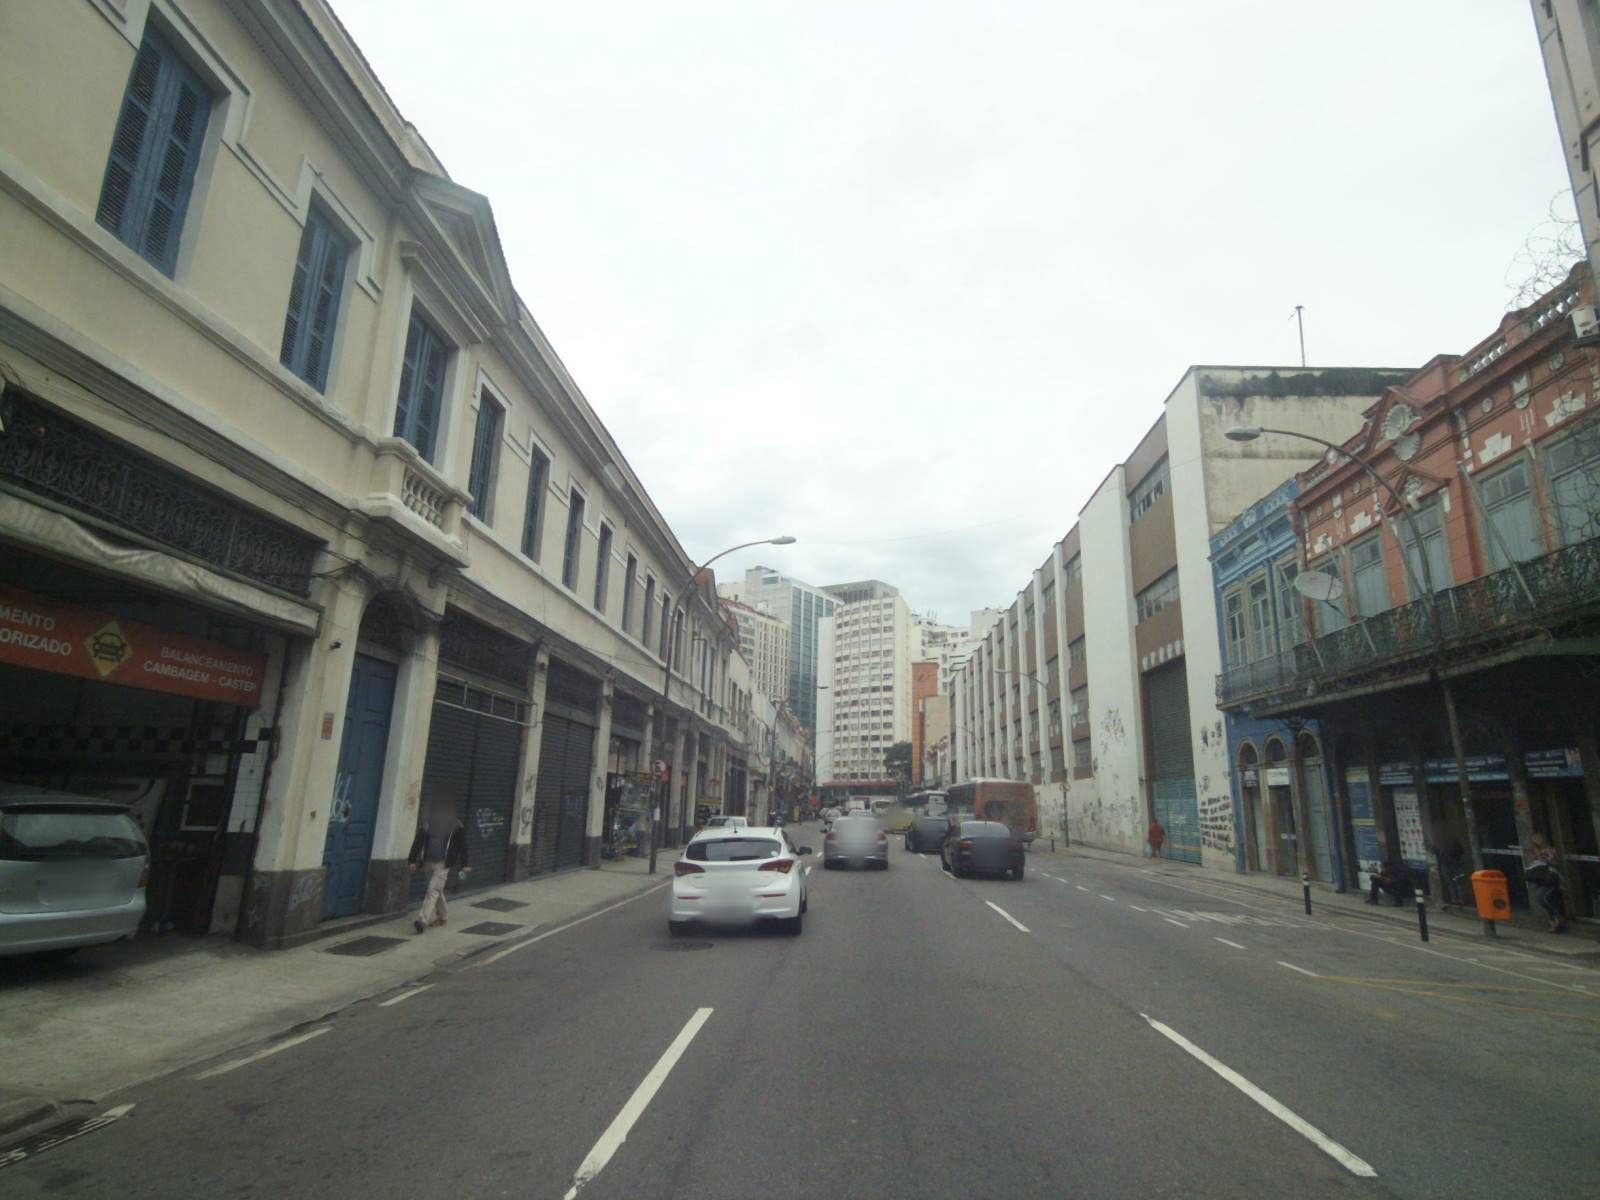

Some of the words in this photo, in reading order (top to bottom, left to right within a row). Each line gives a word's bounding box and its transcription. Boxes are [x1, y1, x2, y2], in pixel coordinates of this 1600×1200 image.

[0, 628, 72, 656] ORIZADO
[143, 660, 210, 683] CAMBAGEM
[218, 676, 257, 693] CASTER
